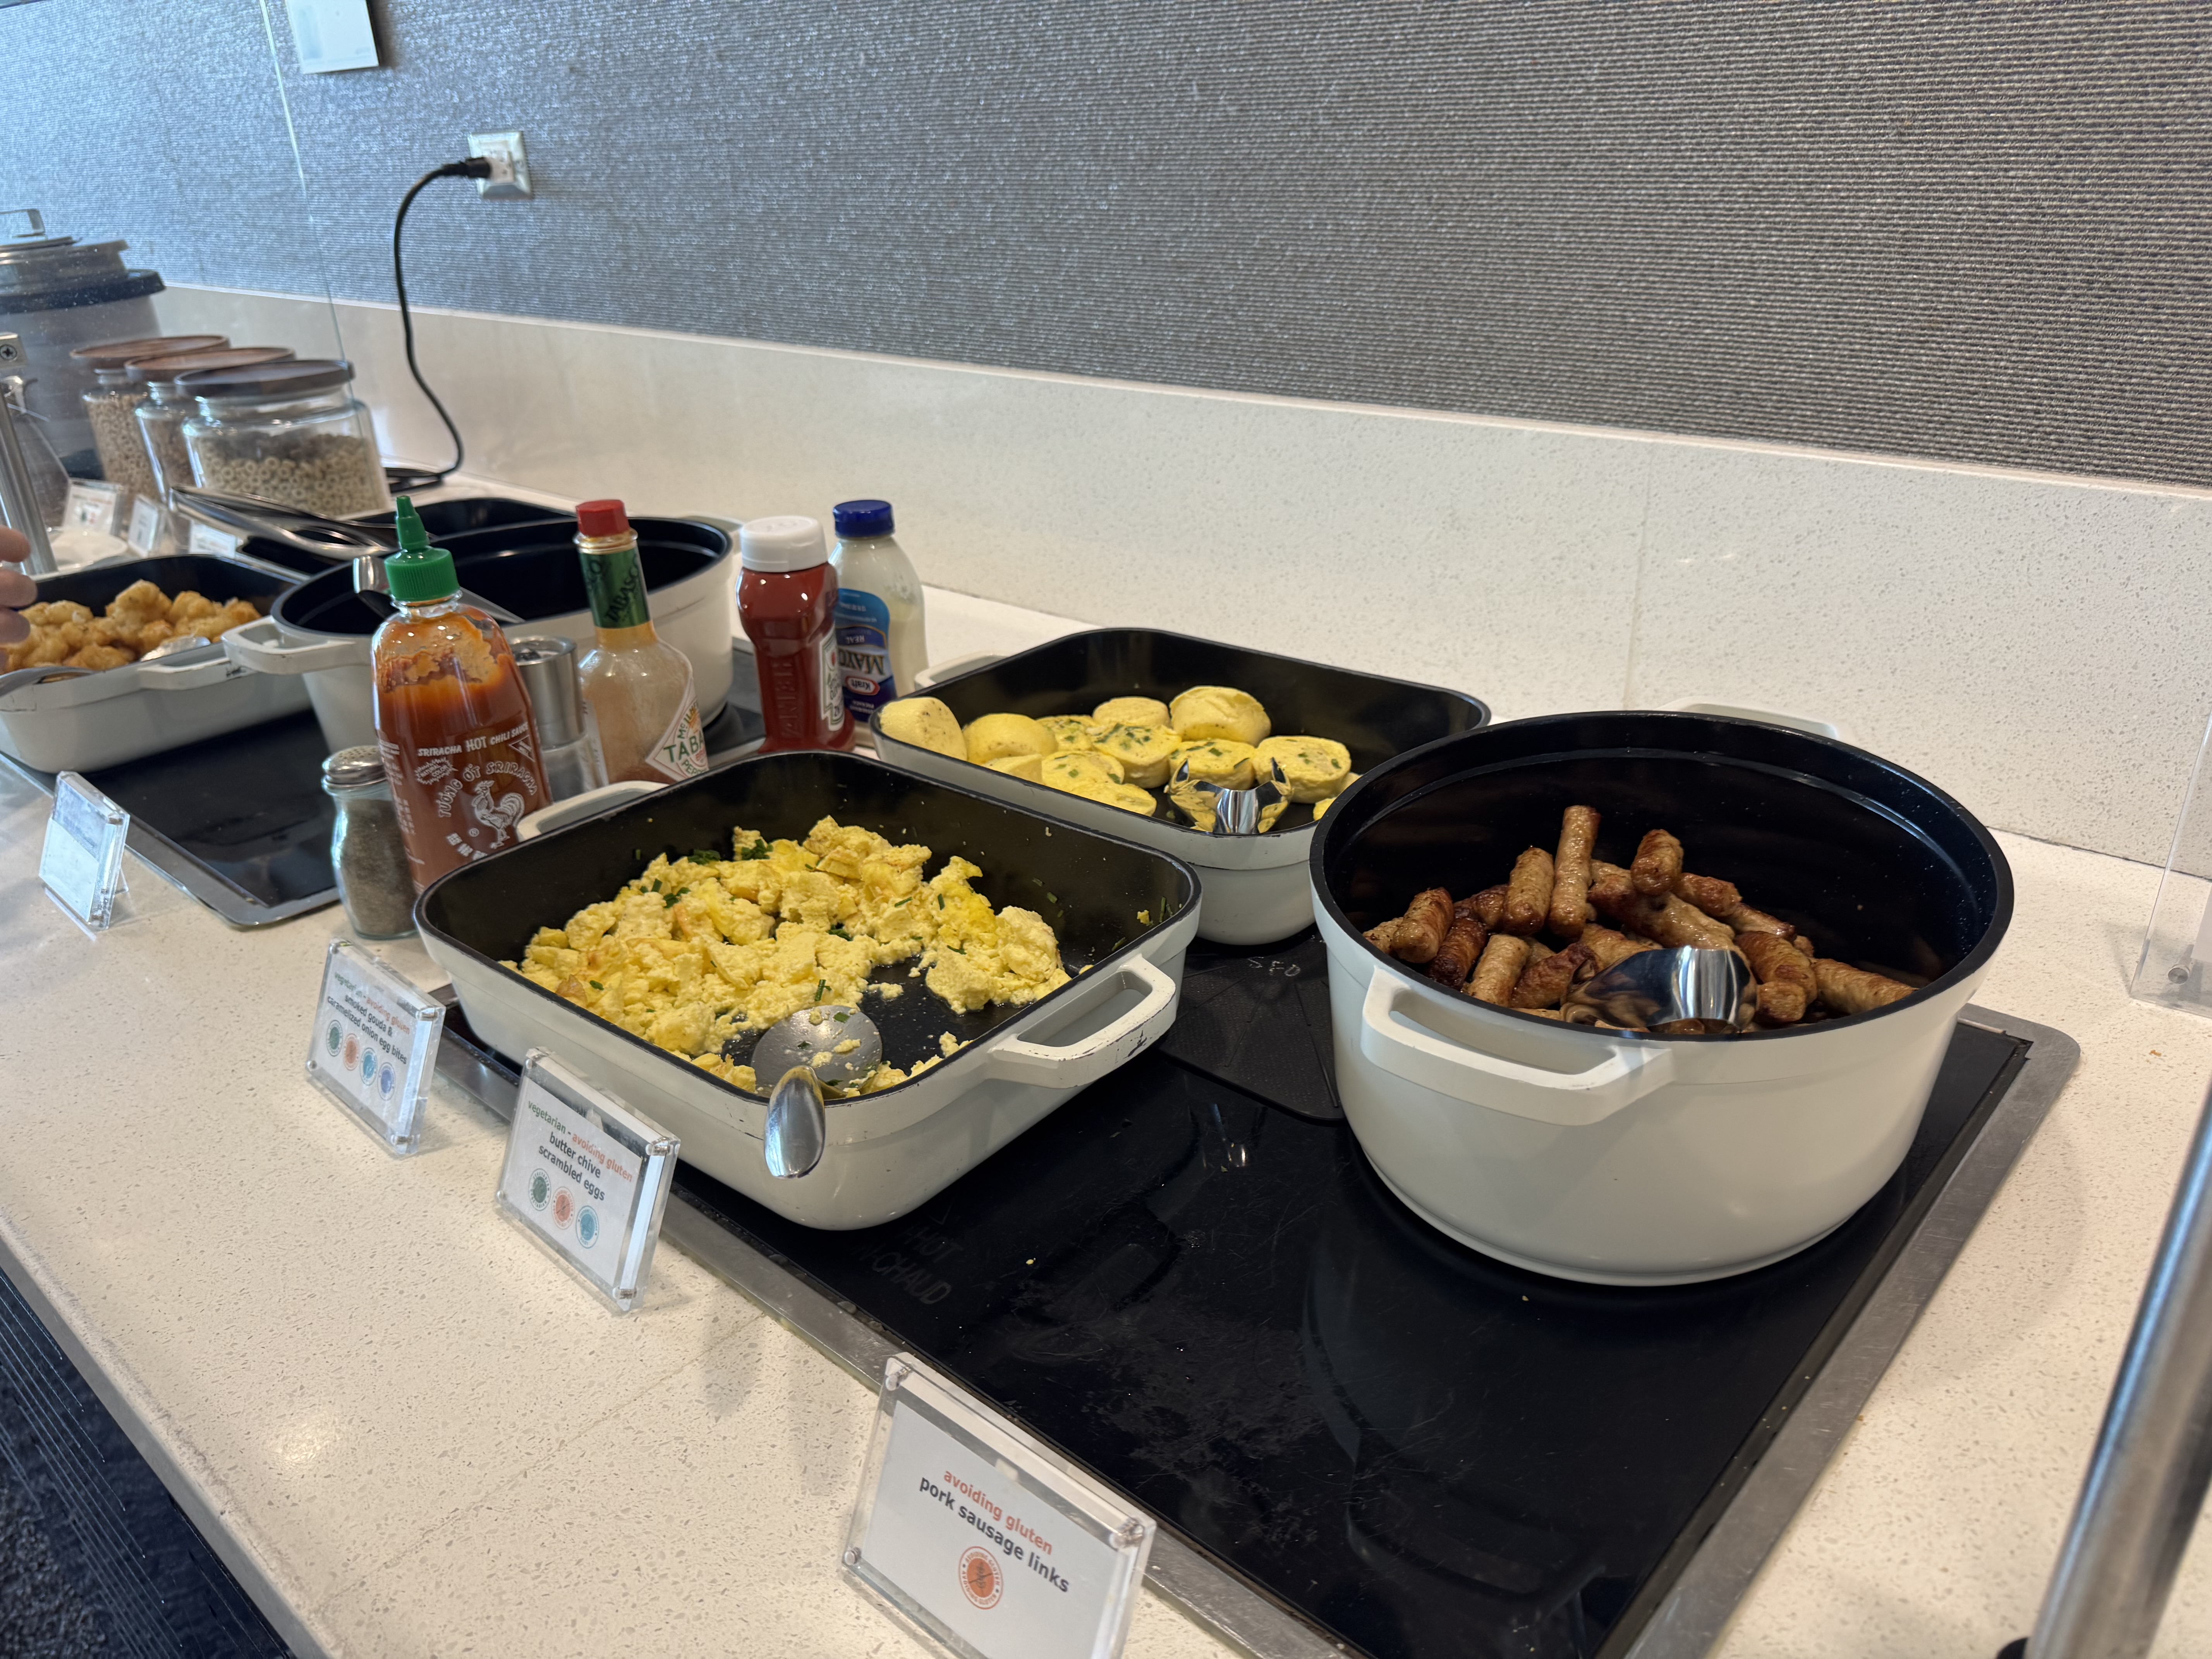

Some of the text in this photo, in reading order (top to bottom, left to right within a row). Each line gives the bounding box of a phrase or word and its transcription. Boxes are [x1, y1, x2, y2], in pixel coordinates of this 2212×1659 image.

[852, 678, 871, 691] Kraft
[418, 722, 529, 757] SRIRACHA HOT CHILI SAUCE
[486, 761, 538, 796] SRIRACHA
[328, 996, 361, 1027] caramelized
[362, 1023, 378, 1041] onion
[380, 1038, 391, 1053] egg
[392, 1045, 407, 1064] bites
[345, 994, 392, 1037] smoked gouda &
[366, 997, 391, 1021] avoiding
[392, 1016, 410, 1035] gluten
[528, 1101, 566, 1134] vegetarian
[572, 1134, 605, 1164] avoiding
[606, 1158, 632, 1182] gluten
[550, 1132, 601, 1178] butter chive
[539, 1146, 605, 1200] scrambled eggs
[919, 1477, 1069, 1592] pork sausage links
[943, 1471, 1053, 1555] avoiding gluten
